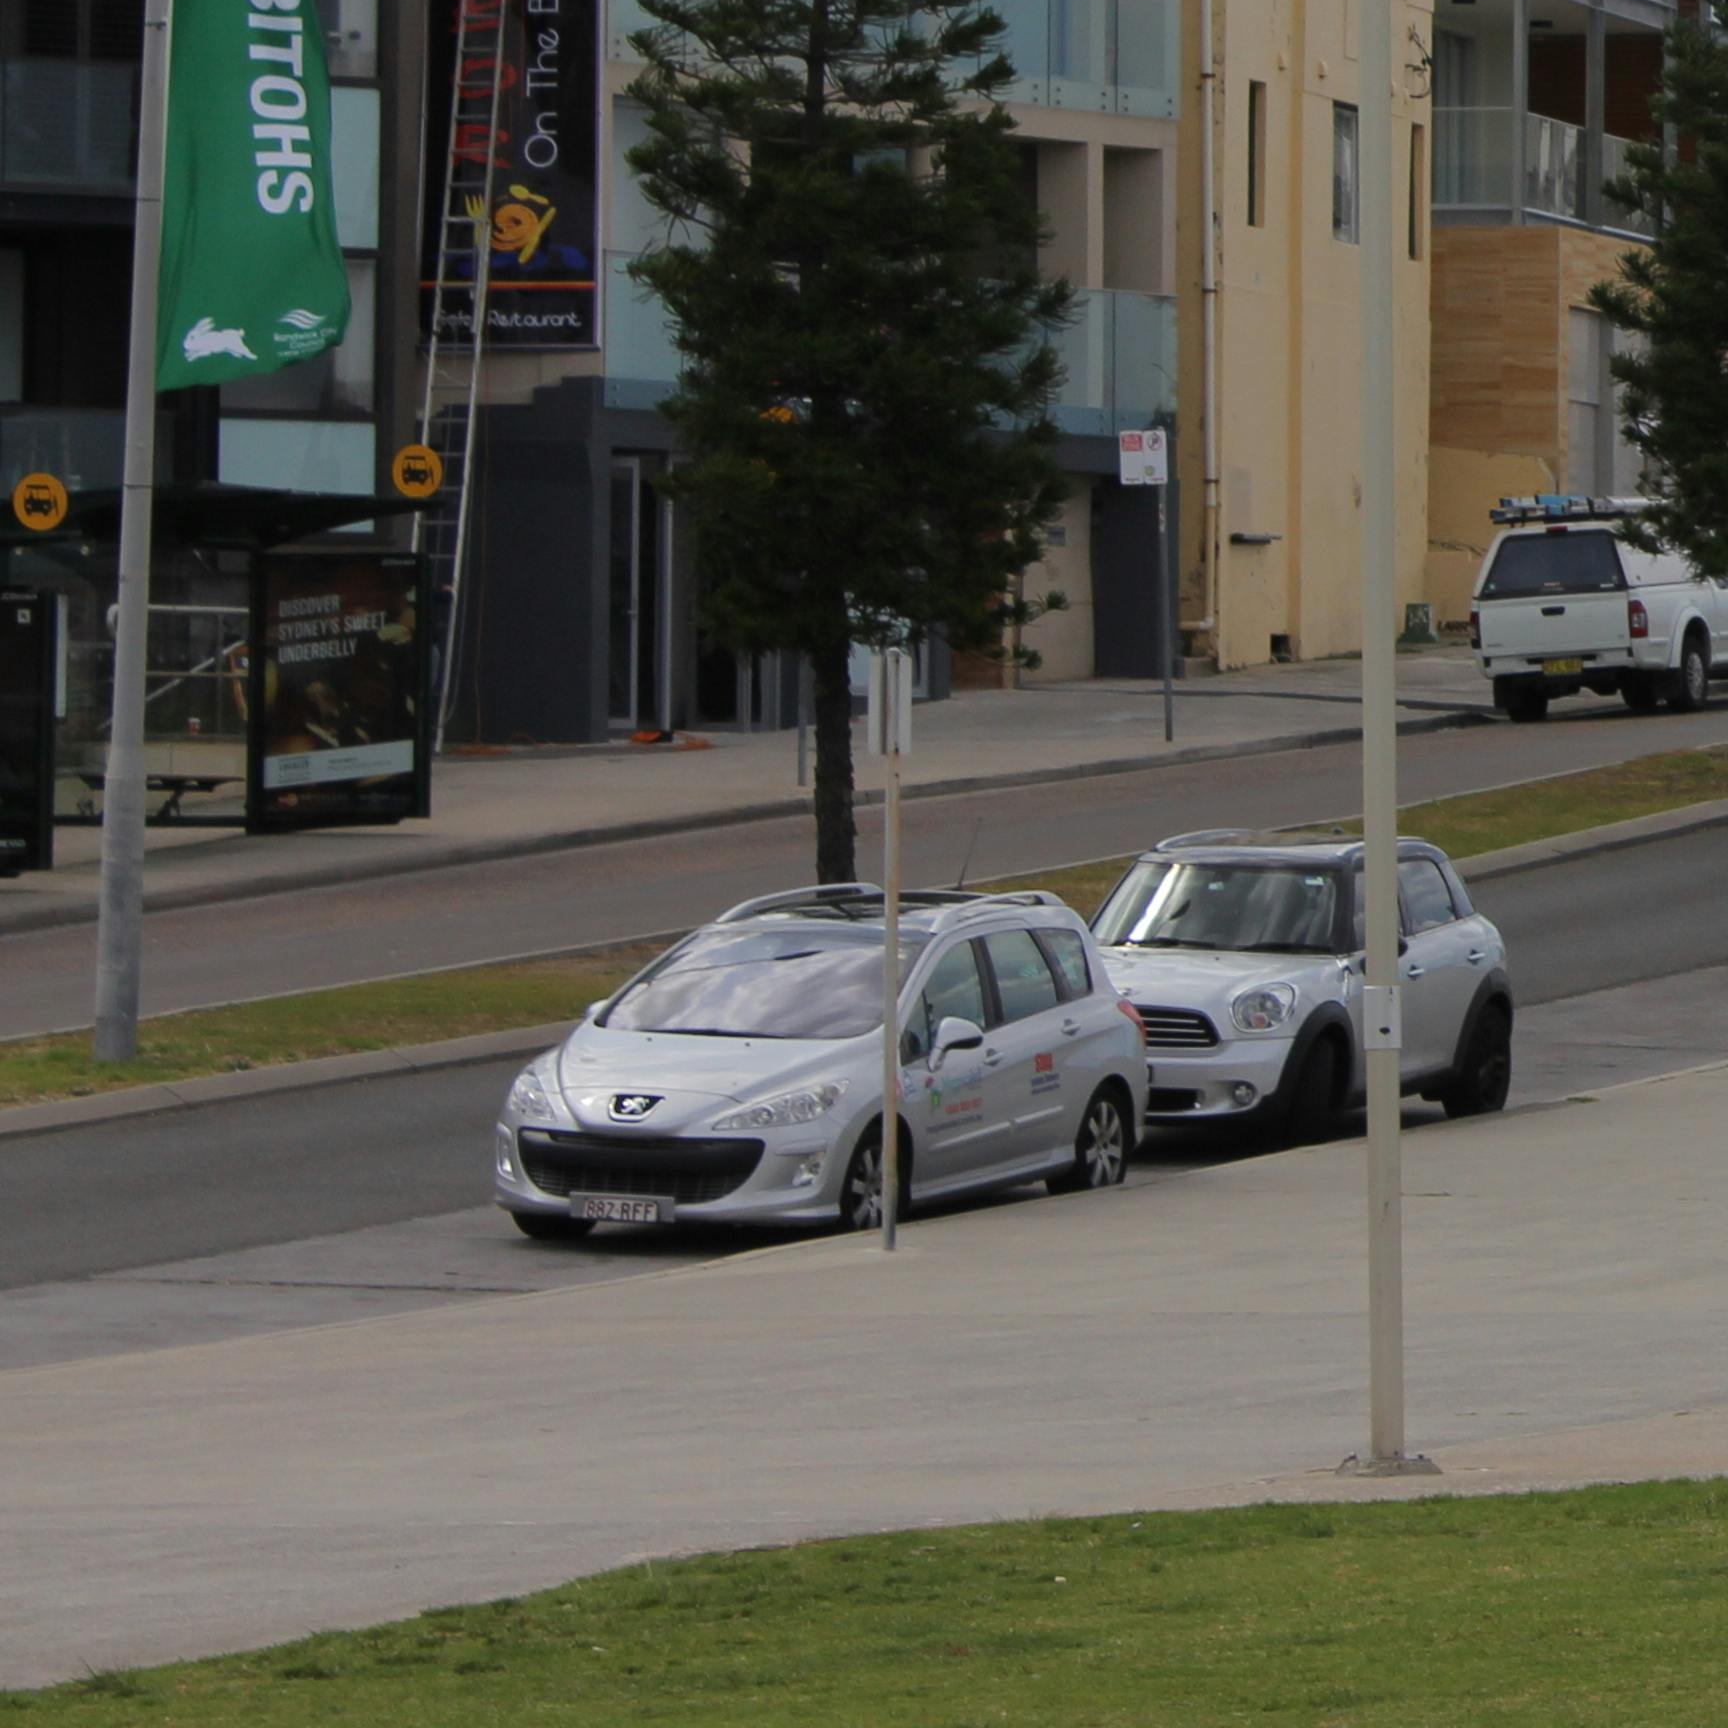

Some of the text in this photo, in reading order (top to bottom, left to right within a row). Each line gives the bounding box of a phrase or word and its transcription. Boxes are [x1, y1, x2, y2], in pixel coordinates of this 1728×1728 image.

[526, 28, 559, 98] The
[525, 111, 558, 168] On
[488, 310, 582, 328] Restaurant
[278, 595, 341, 618] DISCOVER
[278, 611, 387, 641] SYDNEY'S SWEET
[278, 638, 358, 664] UNDERBELLY
